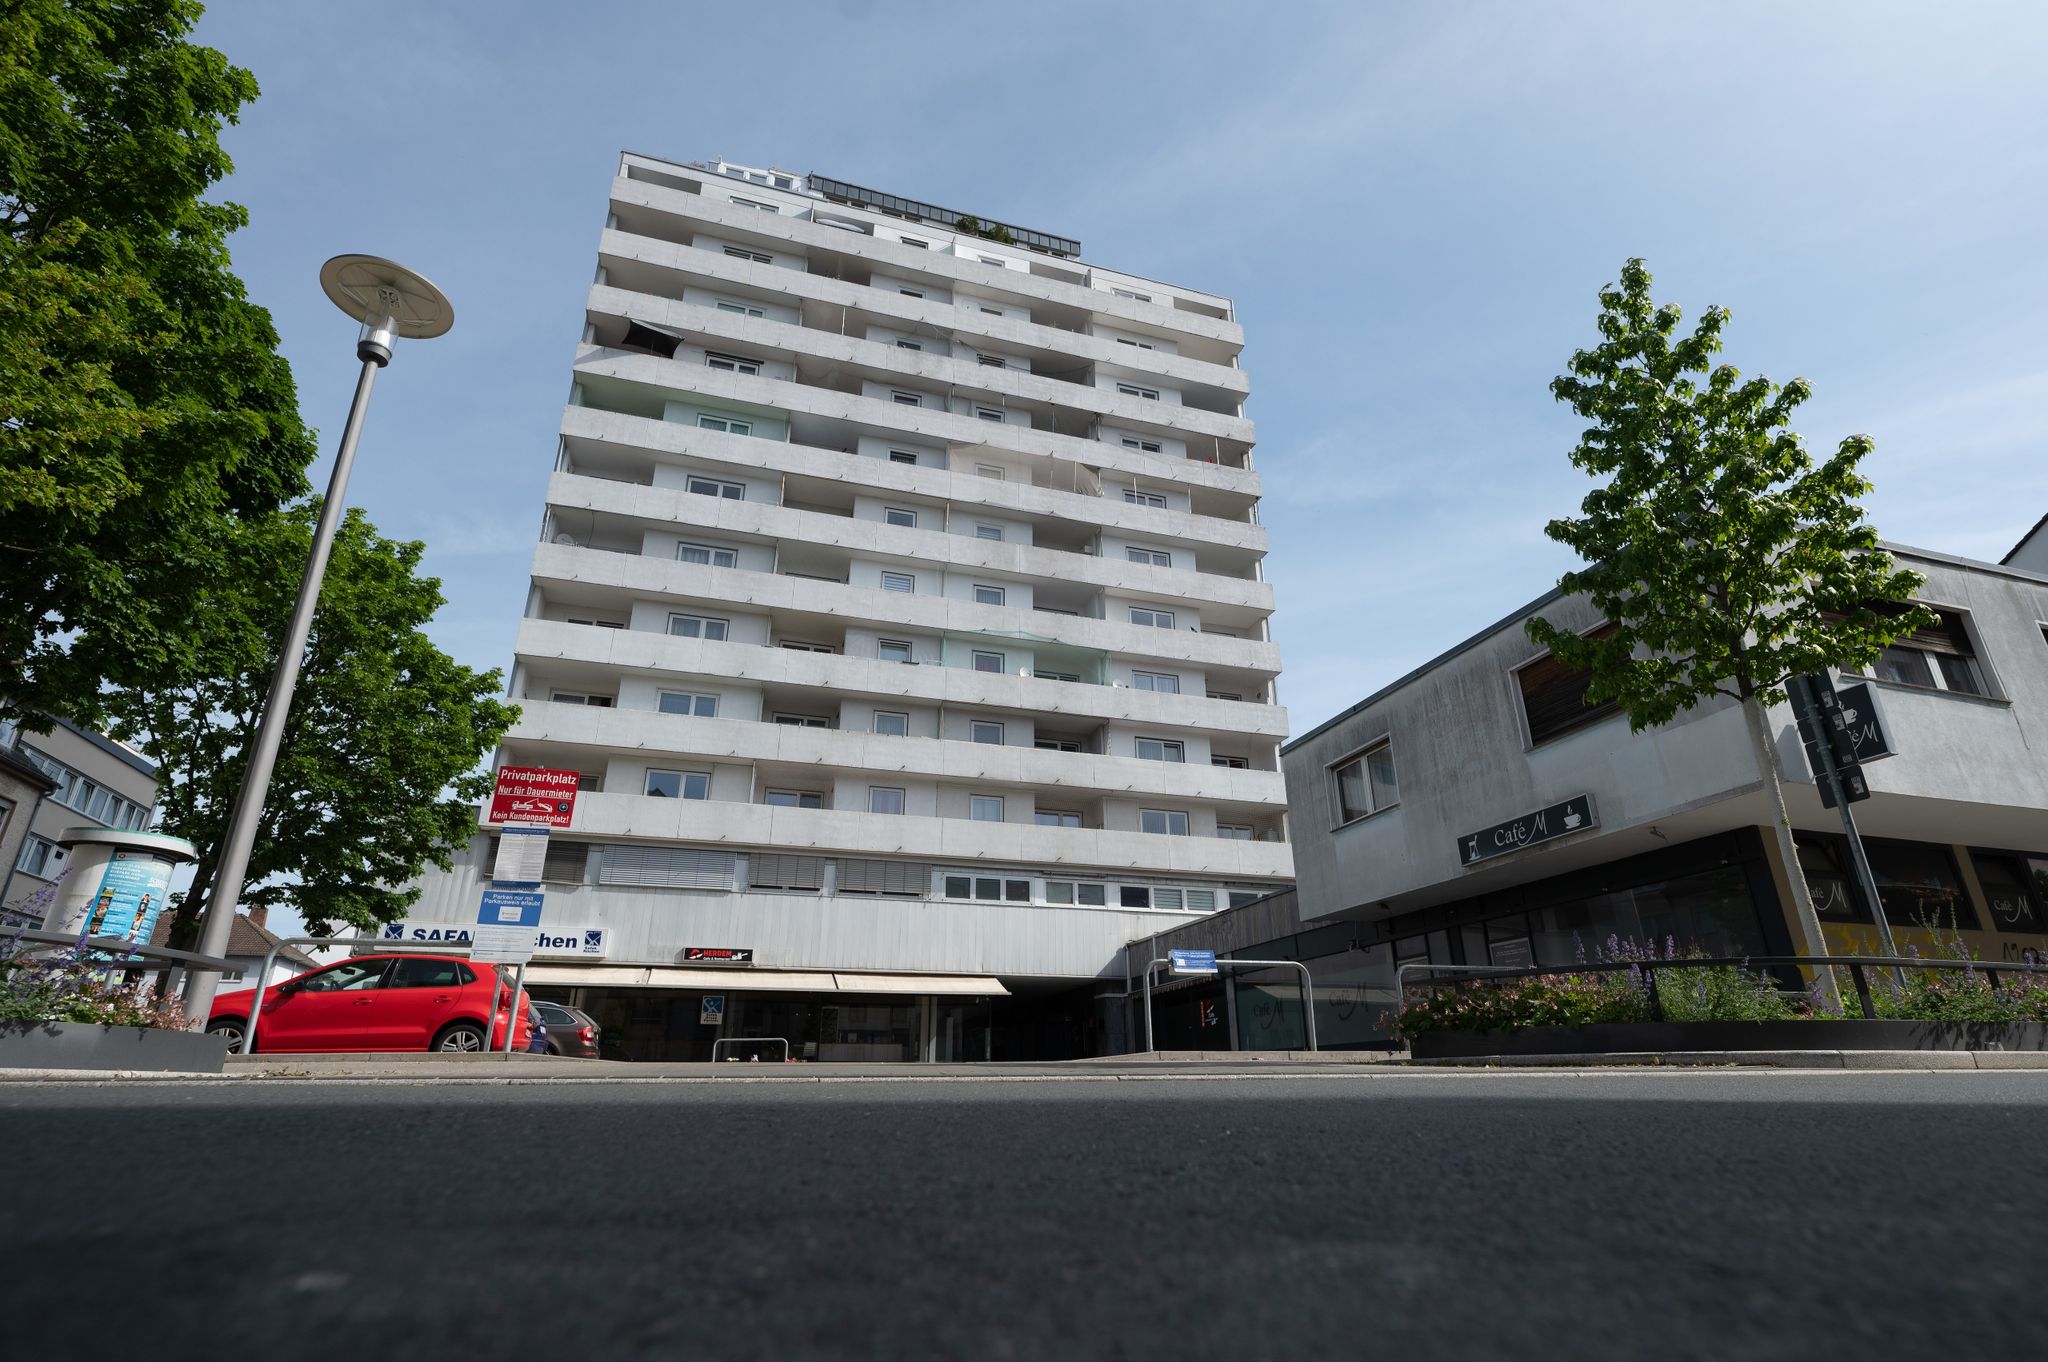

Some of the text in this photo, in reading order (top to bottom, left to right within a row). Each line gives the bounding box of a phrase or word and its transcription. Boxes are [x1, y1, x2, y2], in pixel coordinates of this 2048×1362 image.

[501, 769, 577, 785] Privatparkplatz
[498, 785, 574, 799] Nur für Dauermieter
[492, 811, 570, 824] Kein Kundenparkplatz!
[1494, 811, 1548, 846] Café M
[492, 893, 513, 901] Parken
[520, 899, 541, 907] erlaubt
[1809, 881, 1847, 910] afé M
[2004, 896, 2033, 923] M
[411, 928, 475, 941] SAFA
[533, 933, 578, 949] hen
[703, 949, 732, 957] HERDEM
